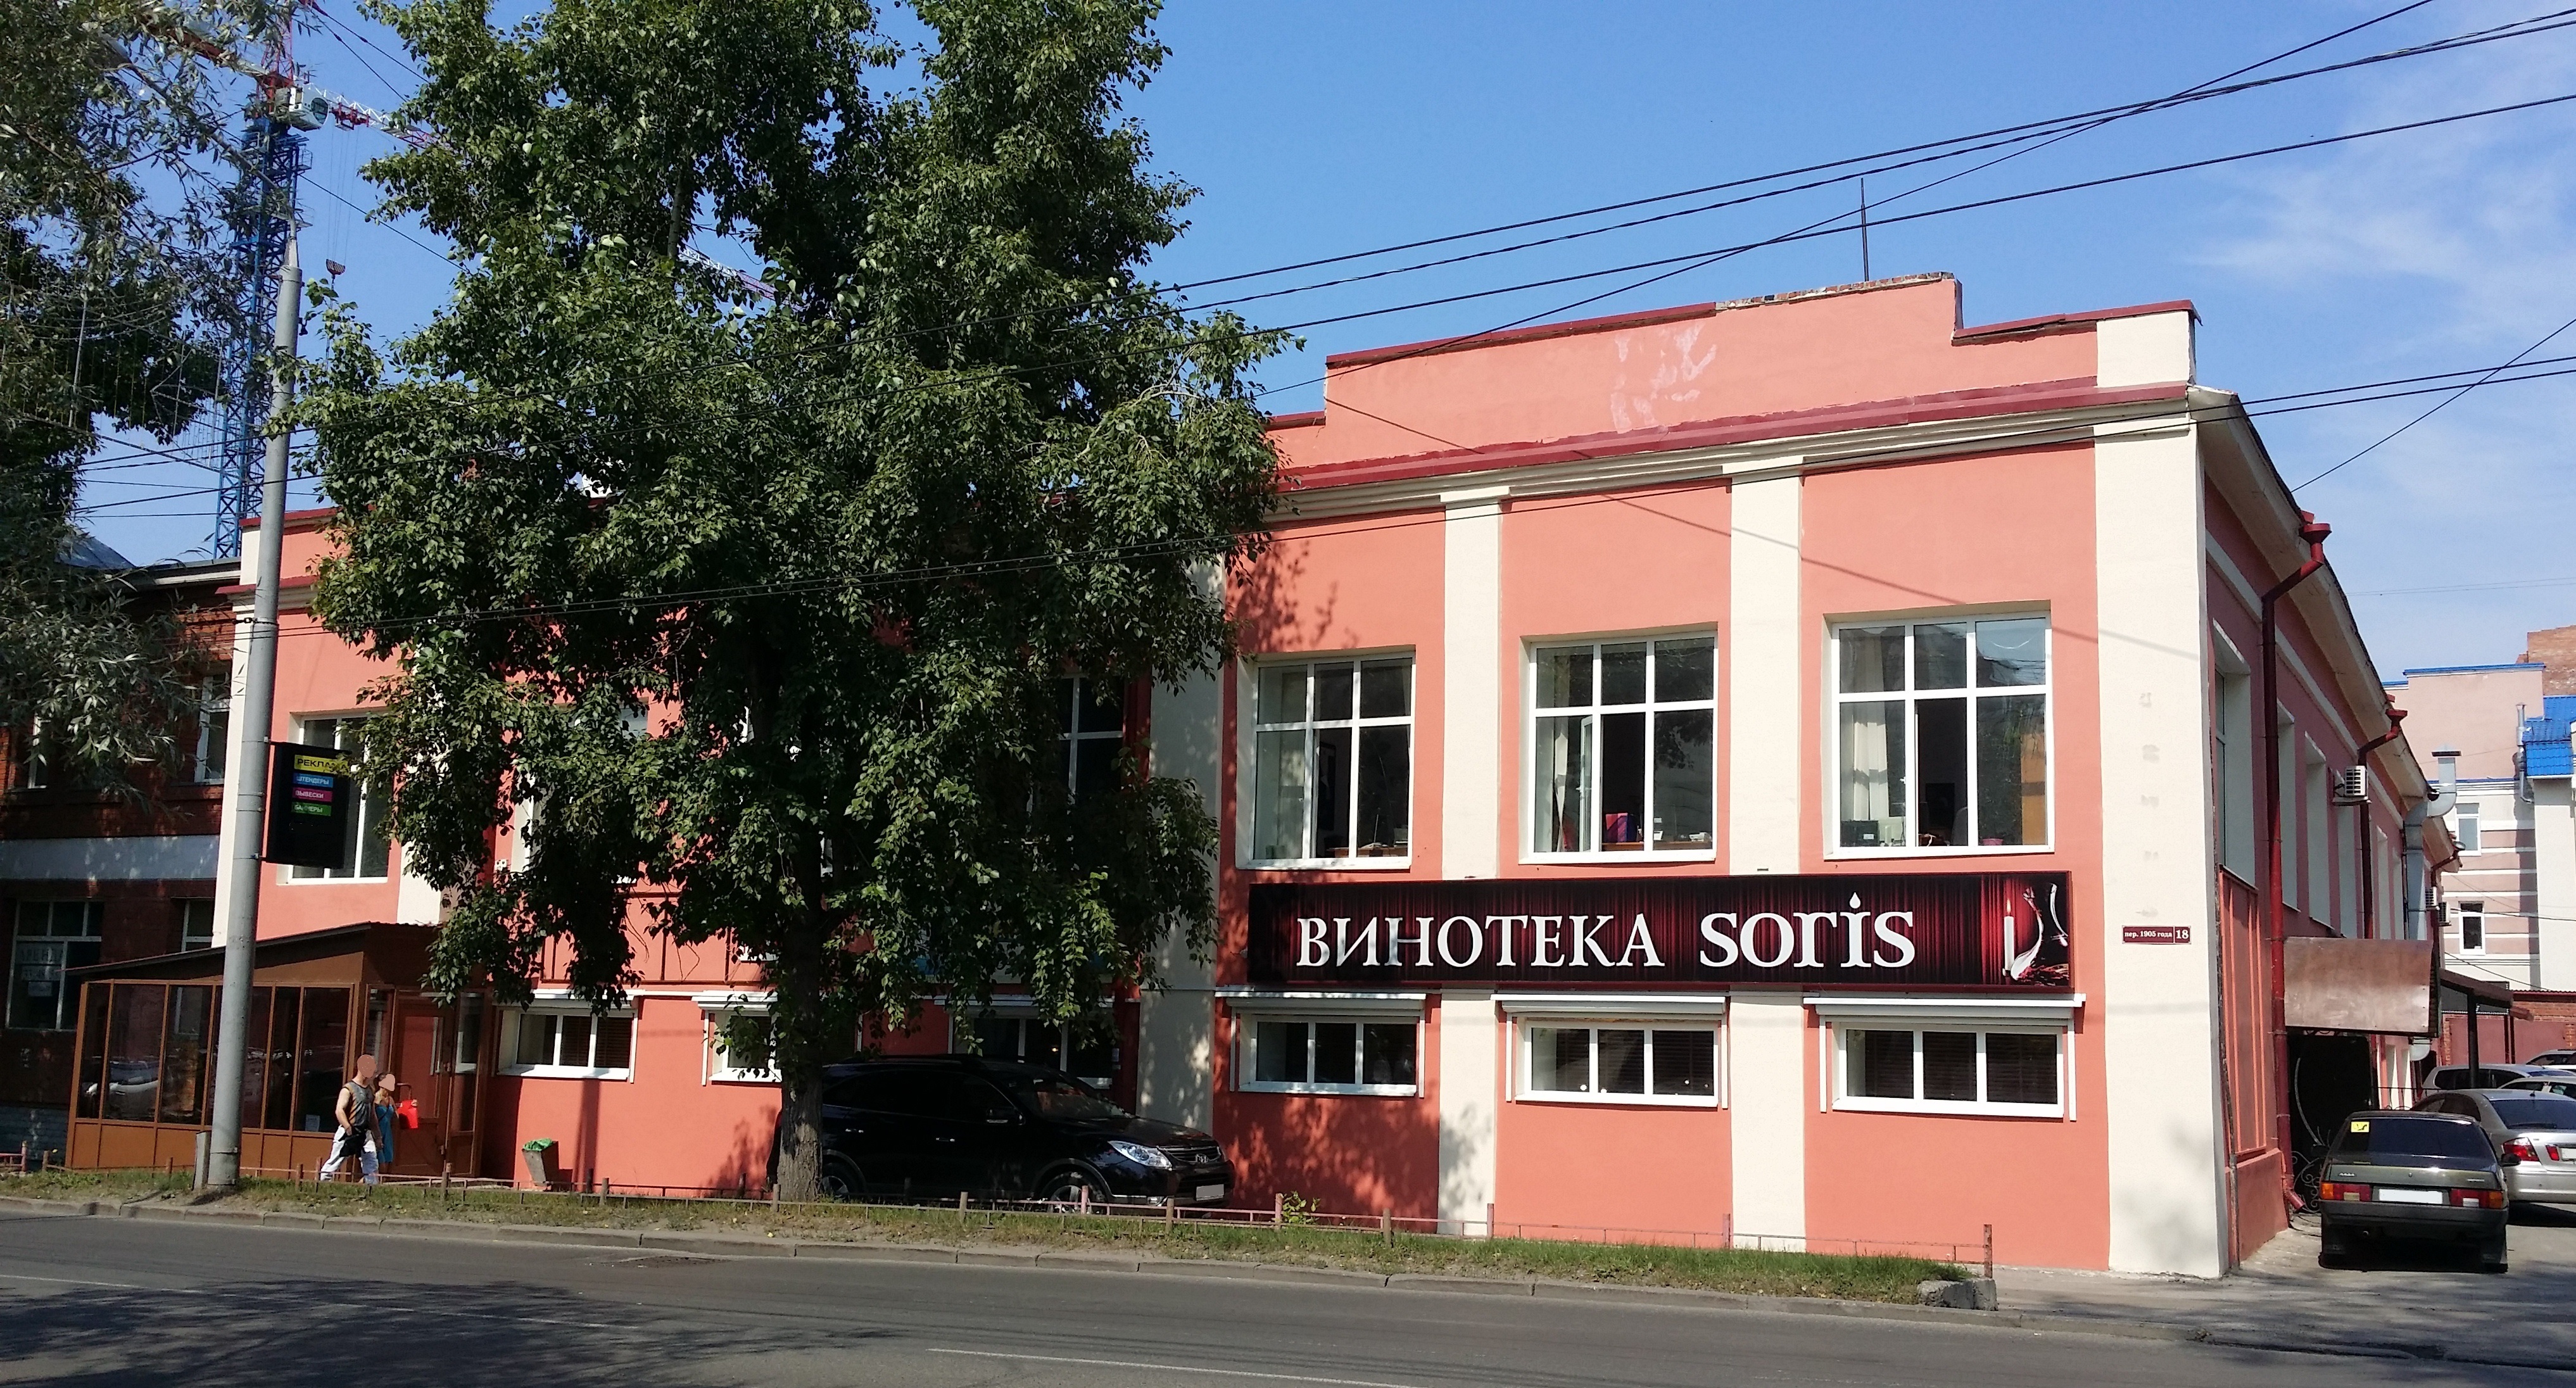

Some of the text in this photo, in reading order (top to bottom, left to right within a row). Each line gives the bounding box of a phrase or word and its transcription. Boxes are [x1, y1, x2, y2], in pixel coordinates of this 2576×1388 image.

[298, 759, 348, 771] РЕКЛАА
[297, 776, 329, 785] ШТЕНДЕРЫ
[296, 790, 324, 798] ВЫВЕСКИ
[2176, 930, 2189, 939] 18
[1296, 913, 1665, 968] ВИНОТЕКА
